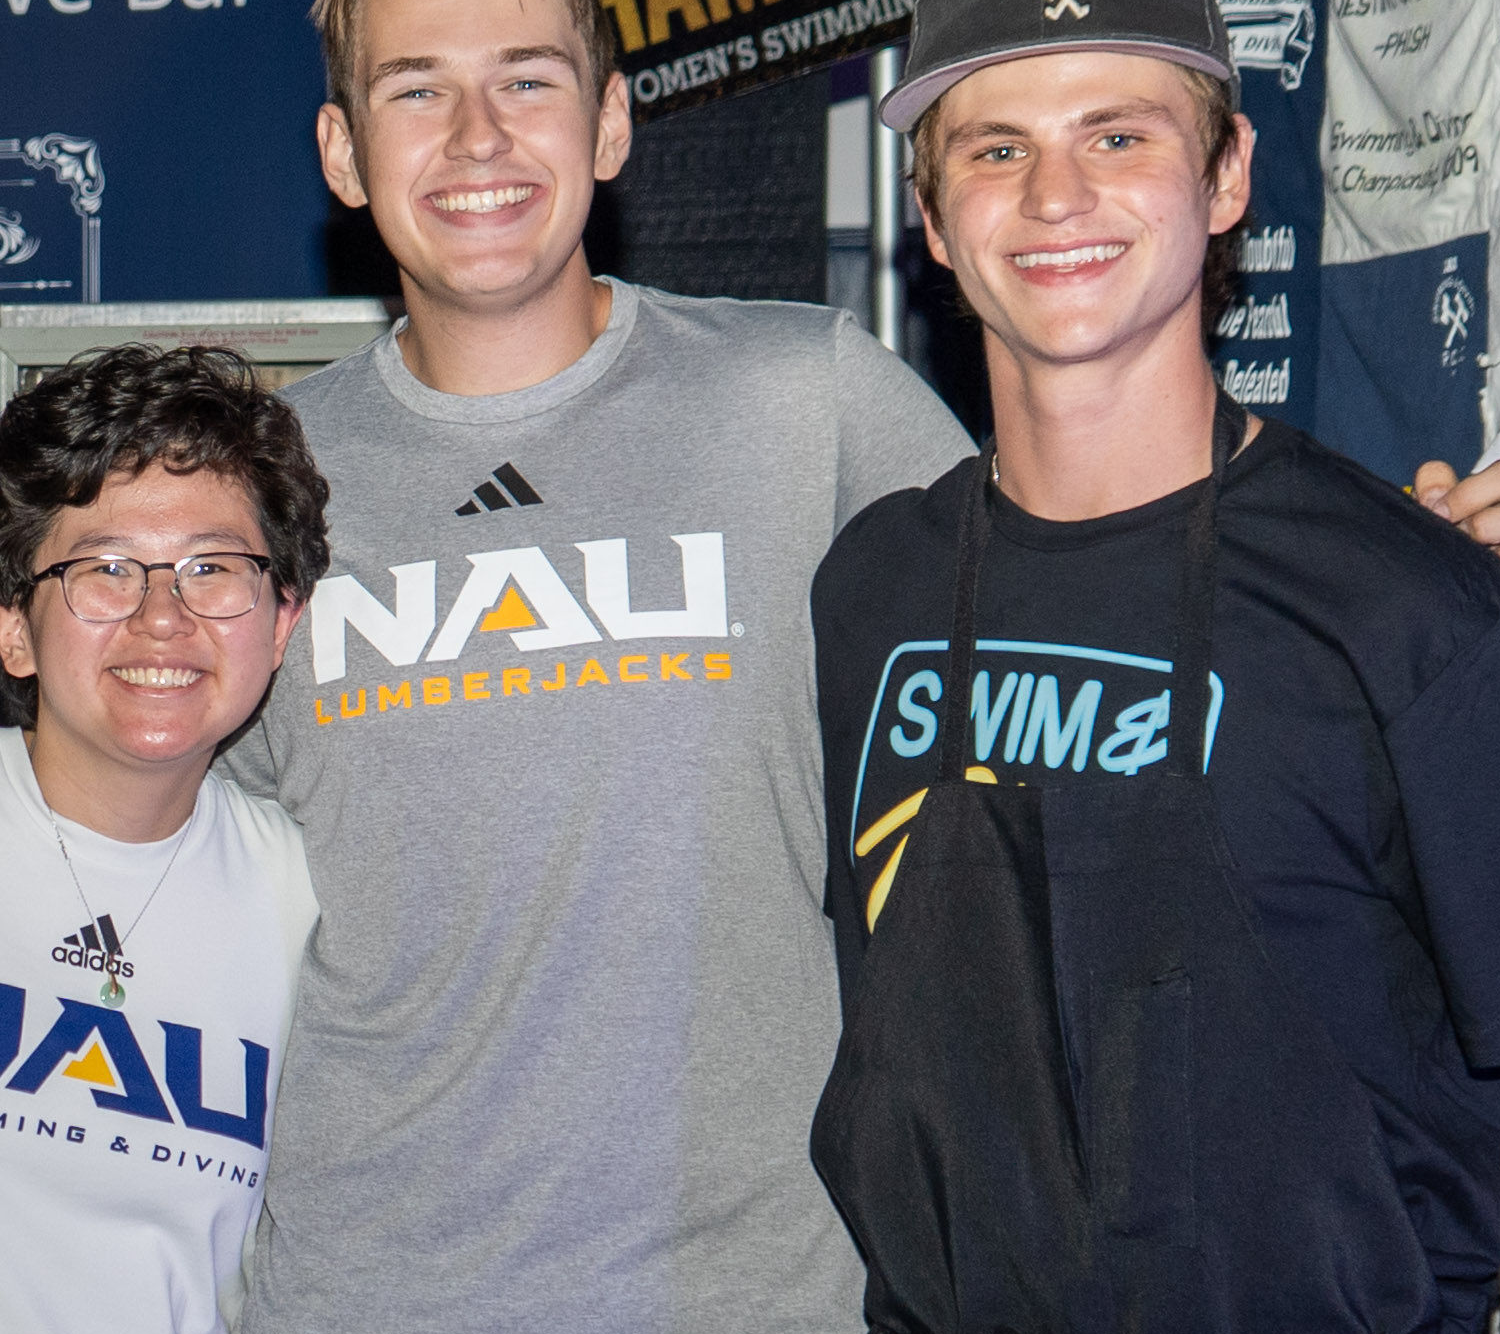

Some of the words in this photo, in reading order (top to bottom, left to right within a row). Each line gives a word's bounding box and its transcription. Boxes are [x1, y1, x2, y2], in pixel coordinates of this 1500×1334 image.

[309, 532, 730, 685] NAU
[315, 651, 733, 727] LUMBERJACKS
[50, 940, 135, 981] adidas
[108, 1133, 131, 1157] &
[151, 1143, 260, 1190] DIVING
